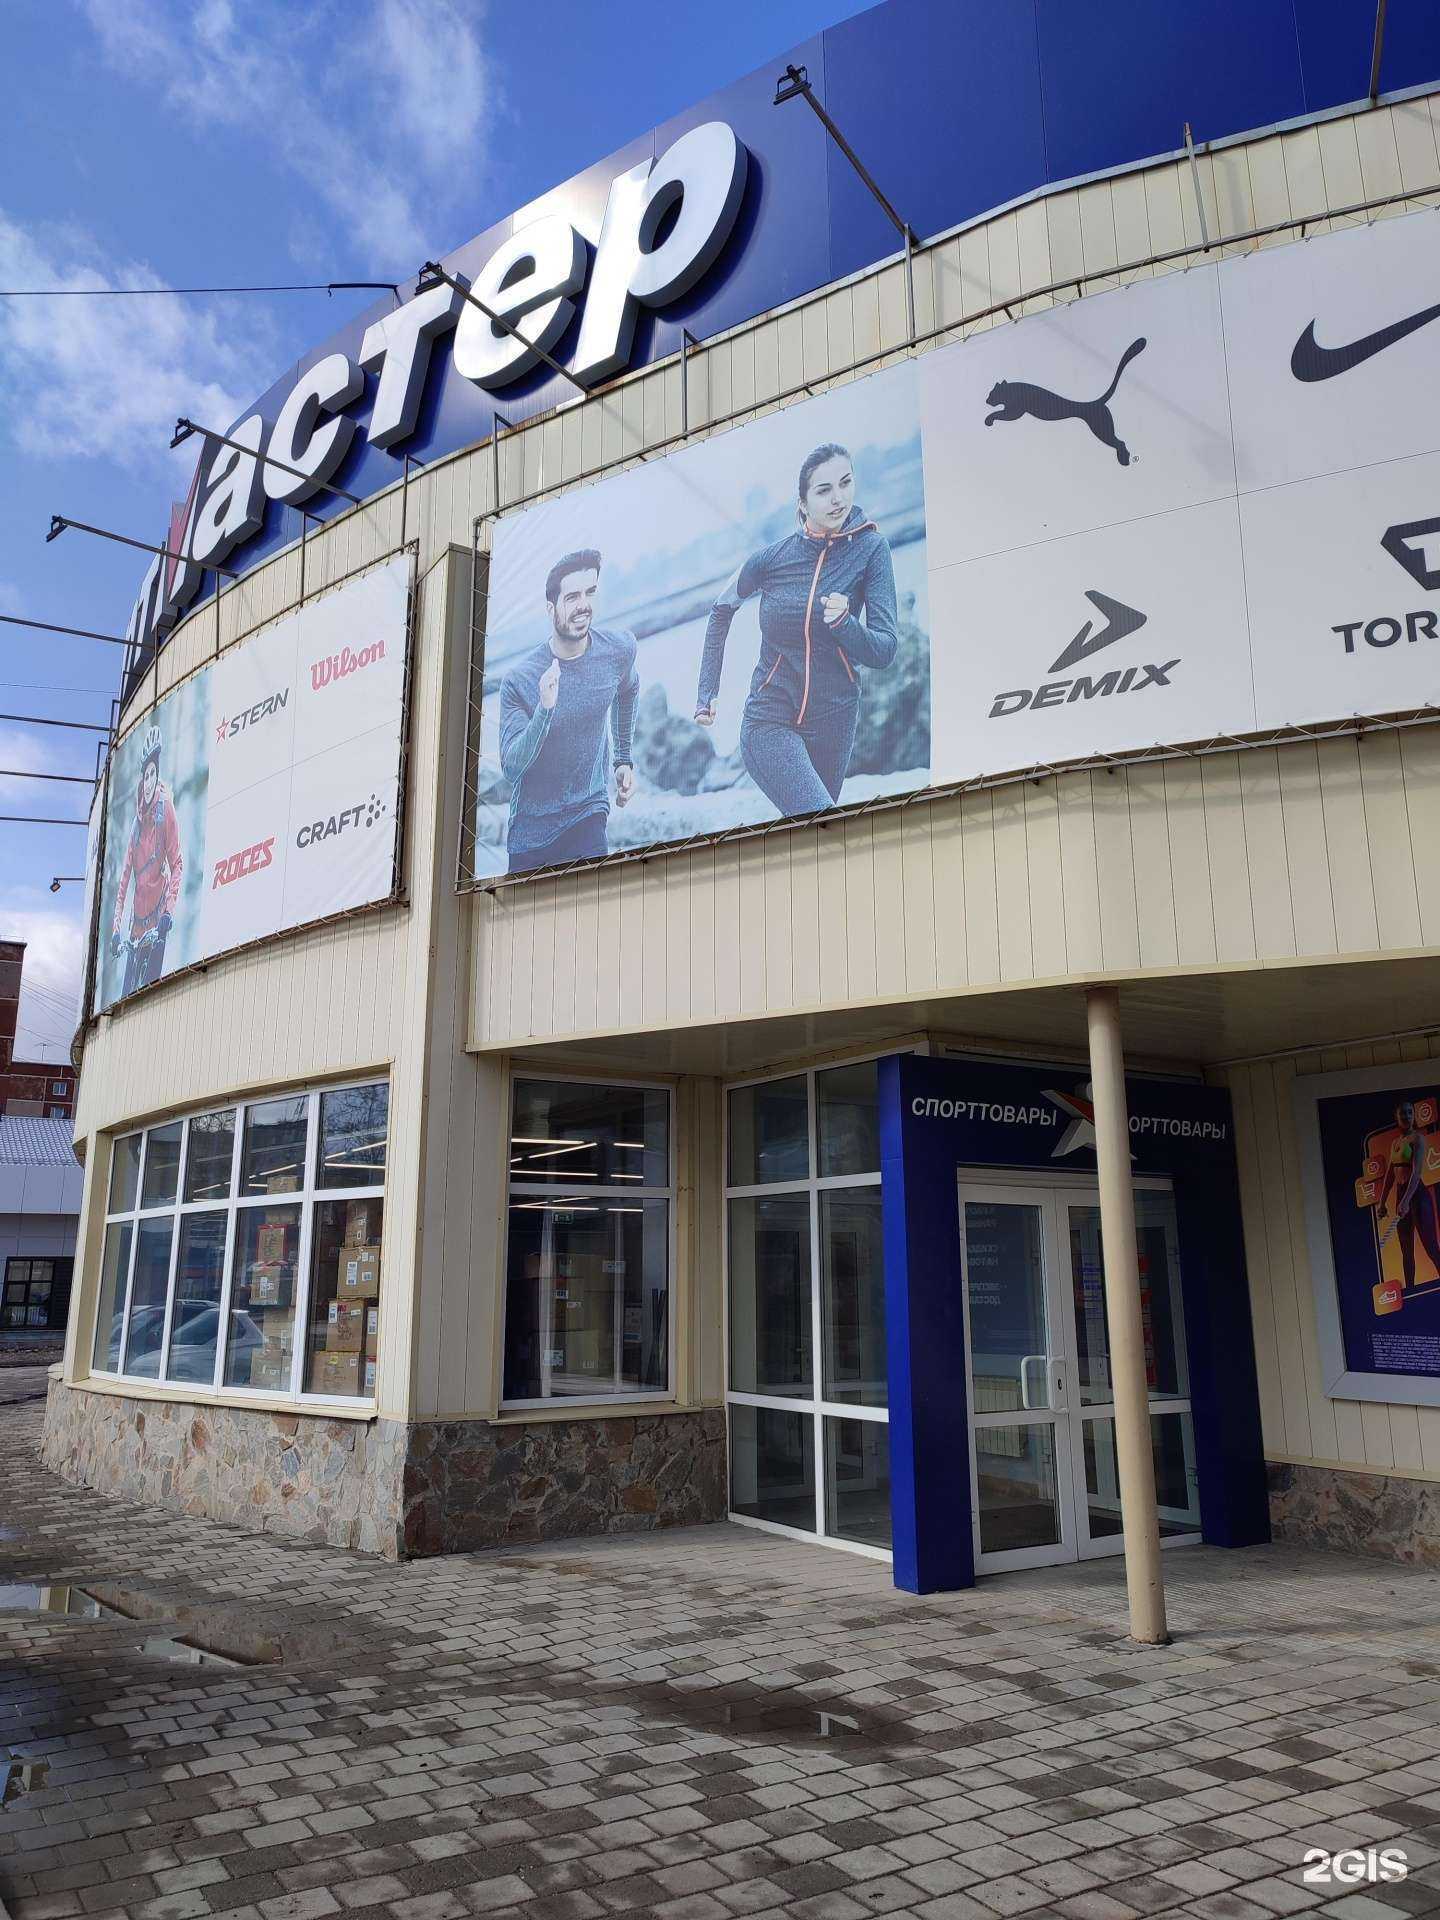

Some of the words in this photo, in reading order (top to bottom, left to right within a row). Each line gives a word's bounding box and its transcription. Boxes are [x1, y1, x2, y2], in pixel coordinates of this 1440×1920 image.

[1331, 610, 1439, 653] TOR
[310, 639, 386, 690] Wilson
[988, 658, 1182, 718] DEMIX
[229, 688, 289, 738] STERN
[296, 804, 366, 849] CRAFT
[212, 837, 275, 889] ROCES
[912, 1097, 1057, 1126] СПОРТТОВАРЫ
[1129, 1116, 1226, 1139] ОРТТОВАРЫ
